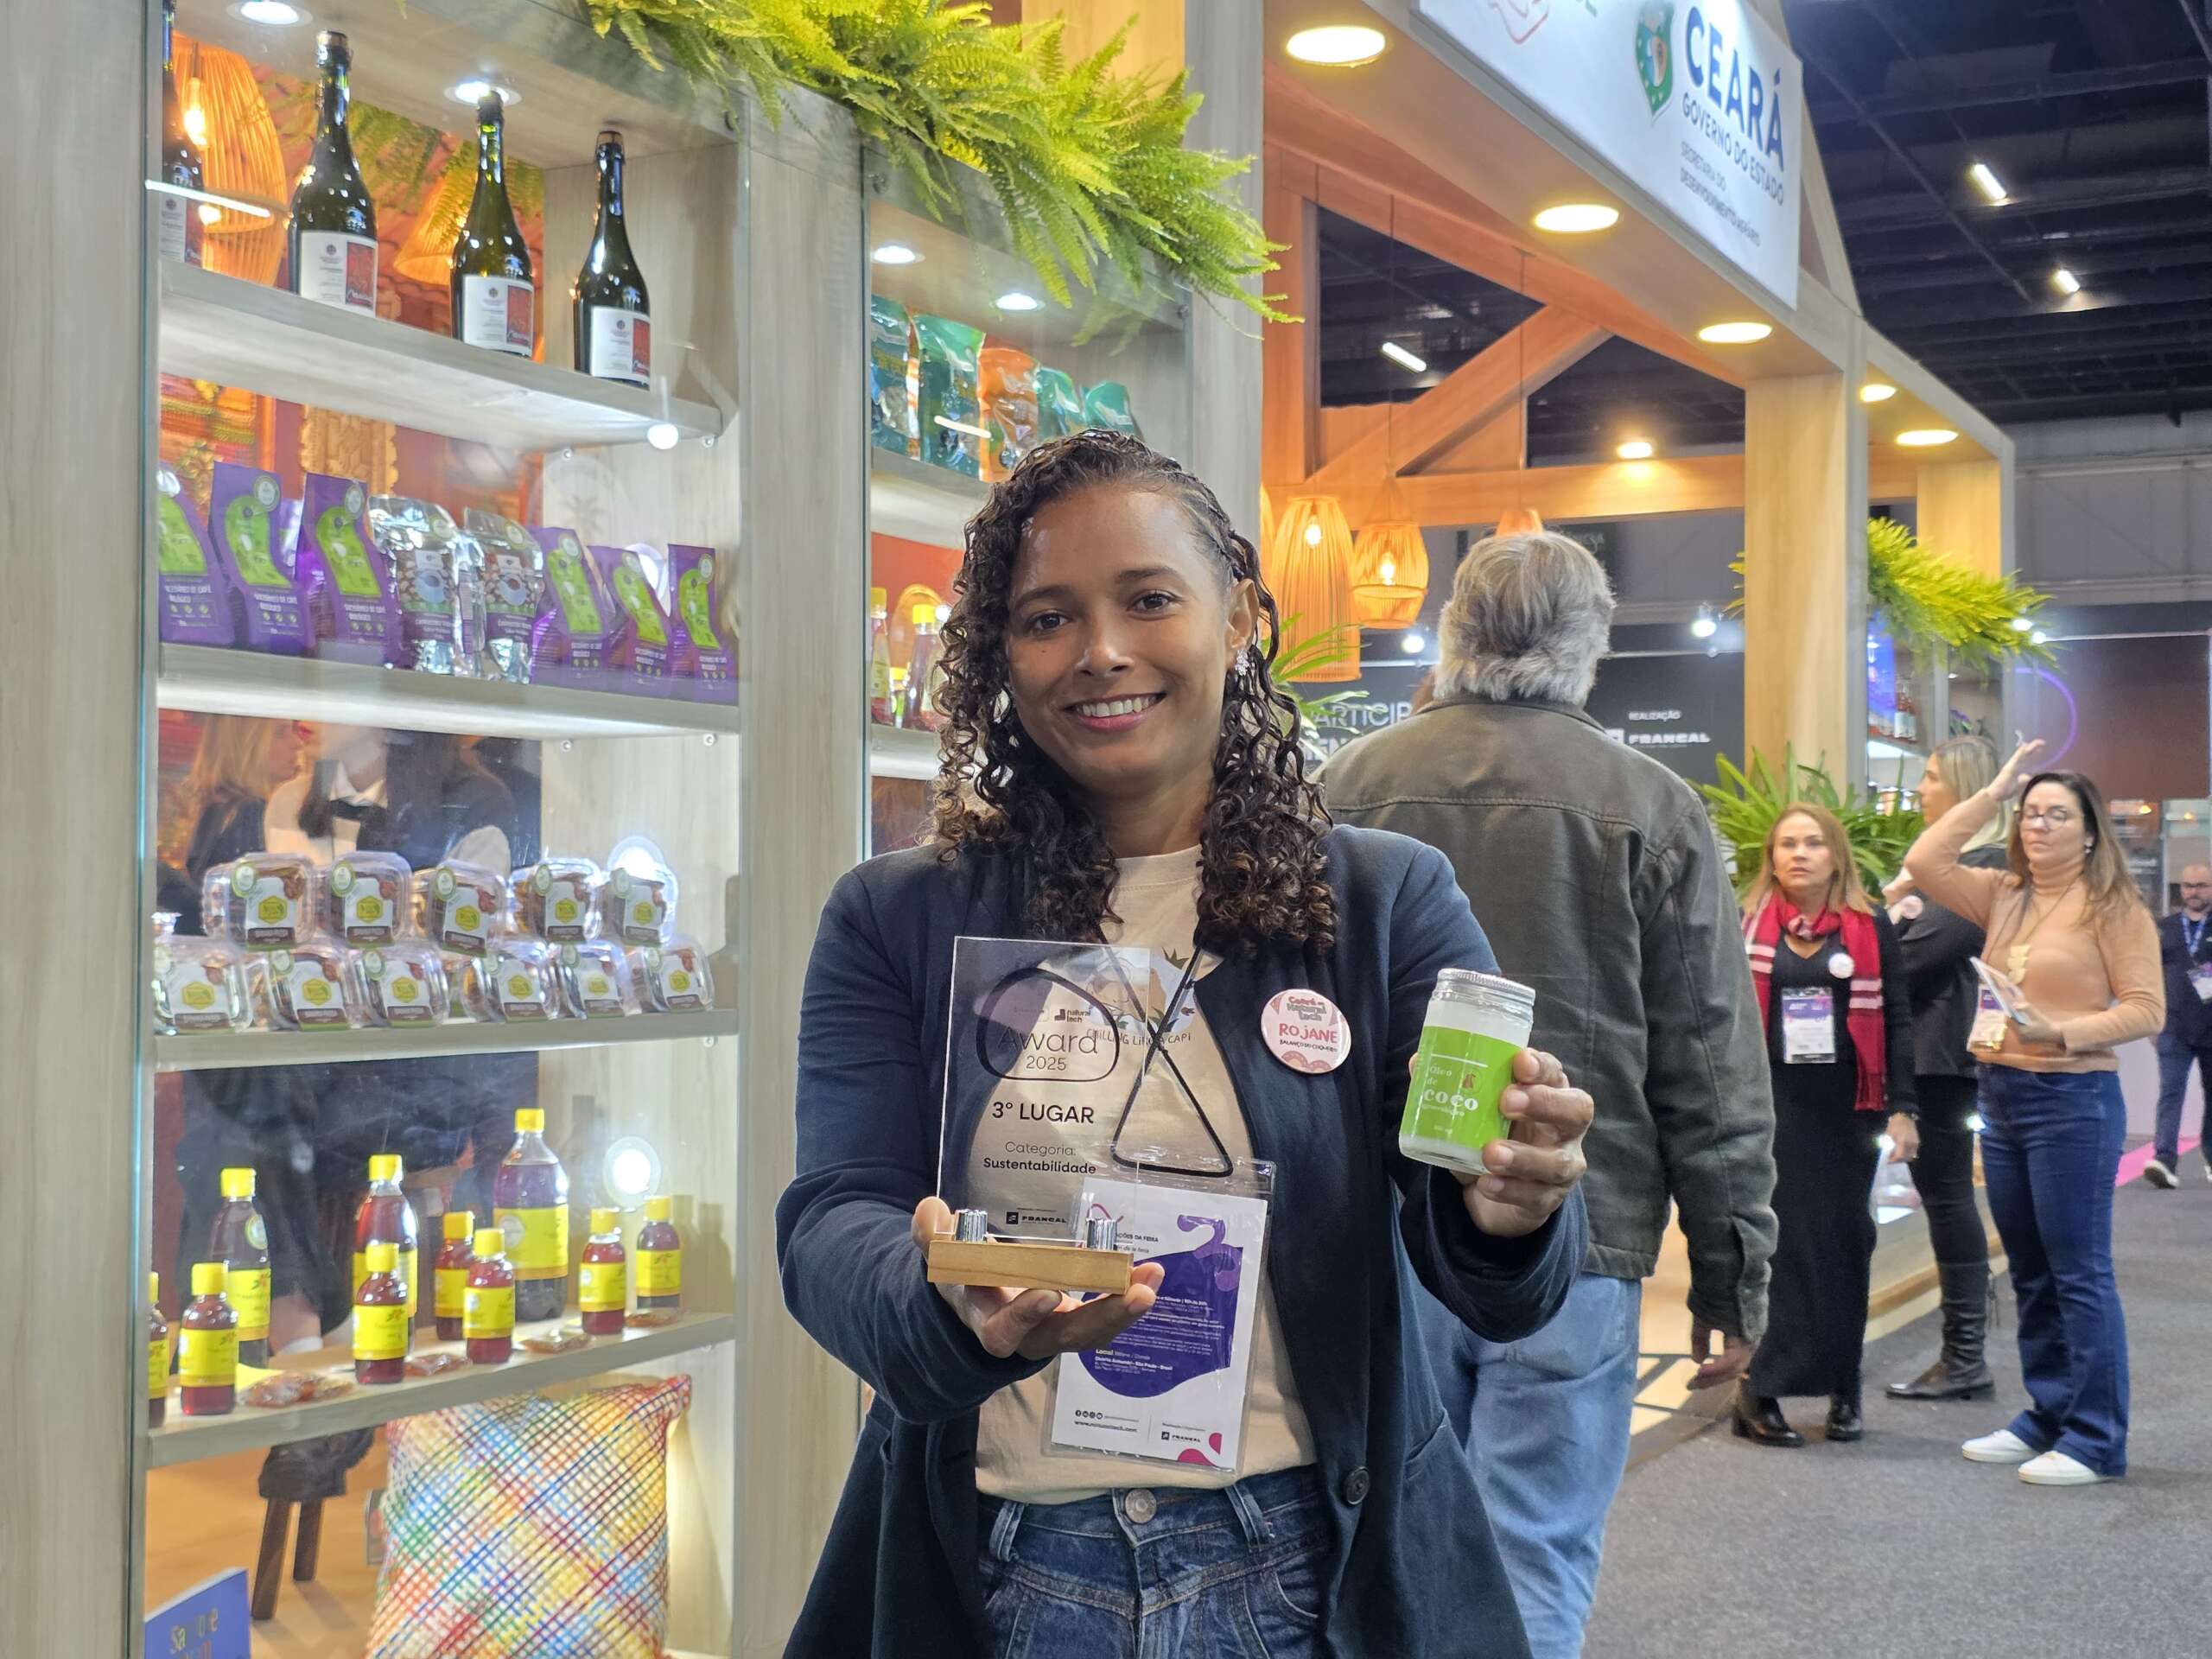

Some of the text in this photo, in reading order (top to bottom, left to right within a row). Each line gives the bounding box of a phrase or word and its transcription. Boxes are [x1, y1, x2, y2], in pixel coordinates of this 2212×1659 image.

[1686, 6, 1784, 172] CEARÁ
[1681, 92, 1784, 206] GOVERNO DO ESTADO
[1629, 710, 1681, 721] REALIZAÇÃO
[1629, 733, 1710, 744] FRANCAL
[997, 1027, 1098, 1054] Award
[1086, 1028, 1129, 1045] CHILLG
[1026, 1056, 1067, 1071] 2025
[1423, 1089, 1478, 1111] coco
[1020, 1103, 1094, 1123] LUGAR
[1005, 1141, 1077, 1157] Categoria:
[983, 1158, 1096, 1174] Sustentabilidade
